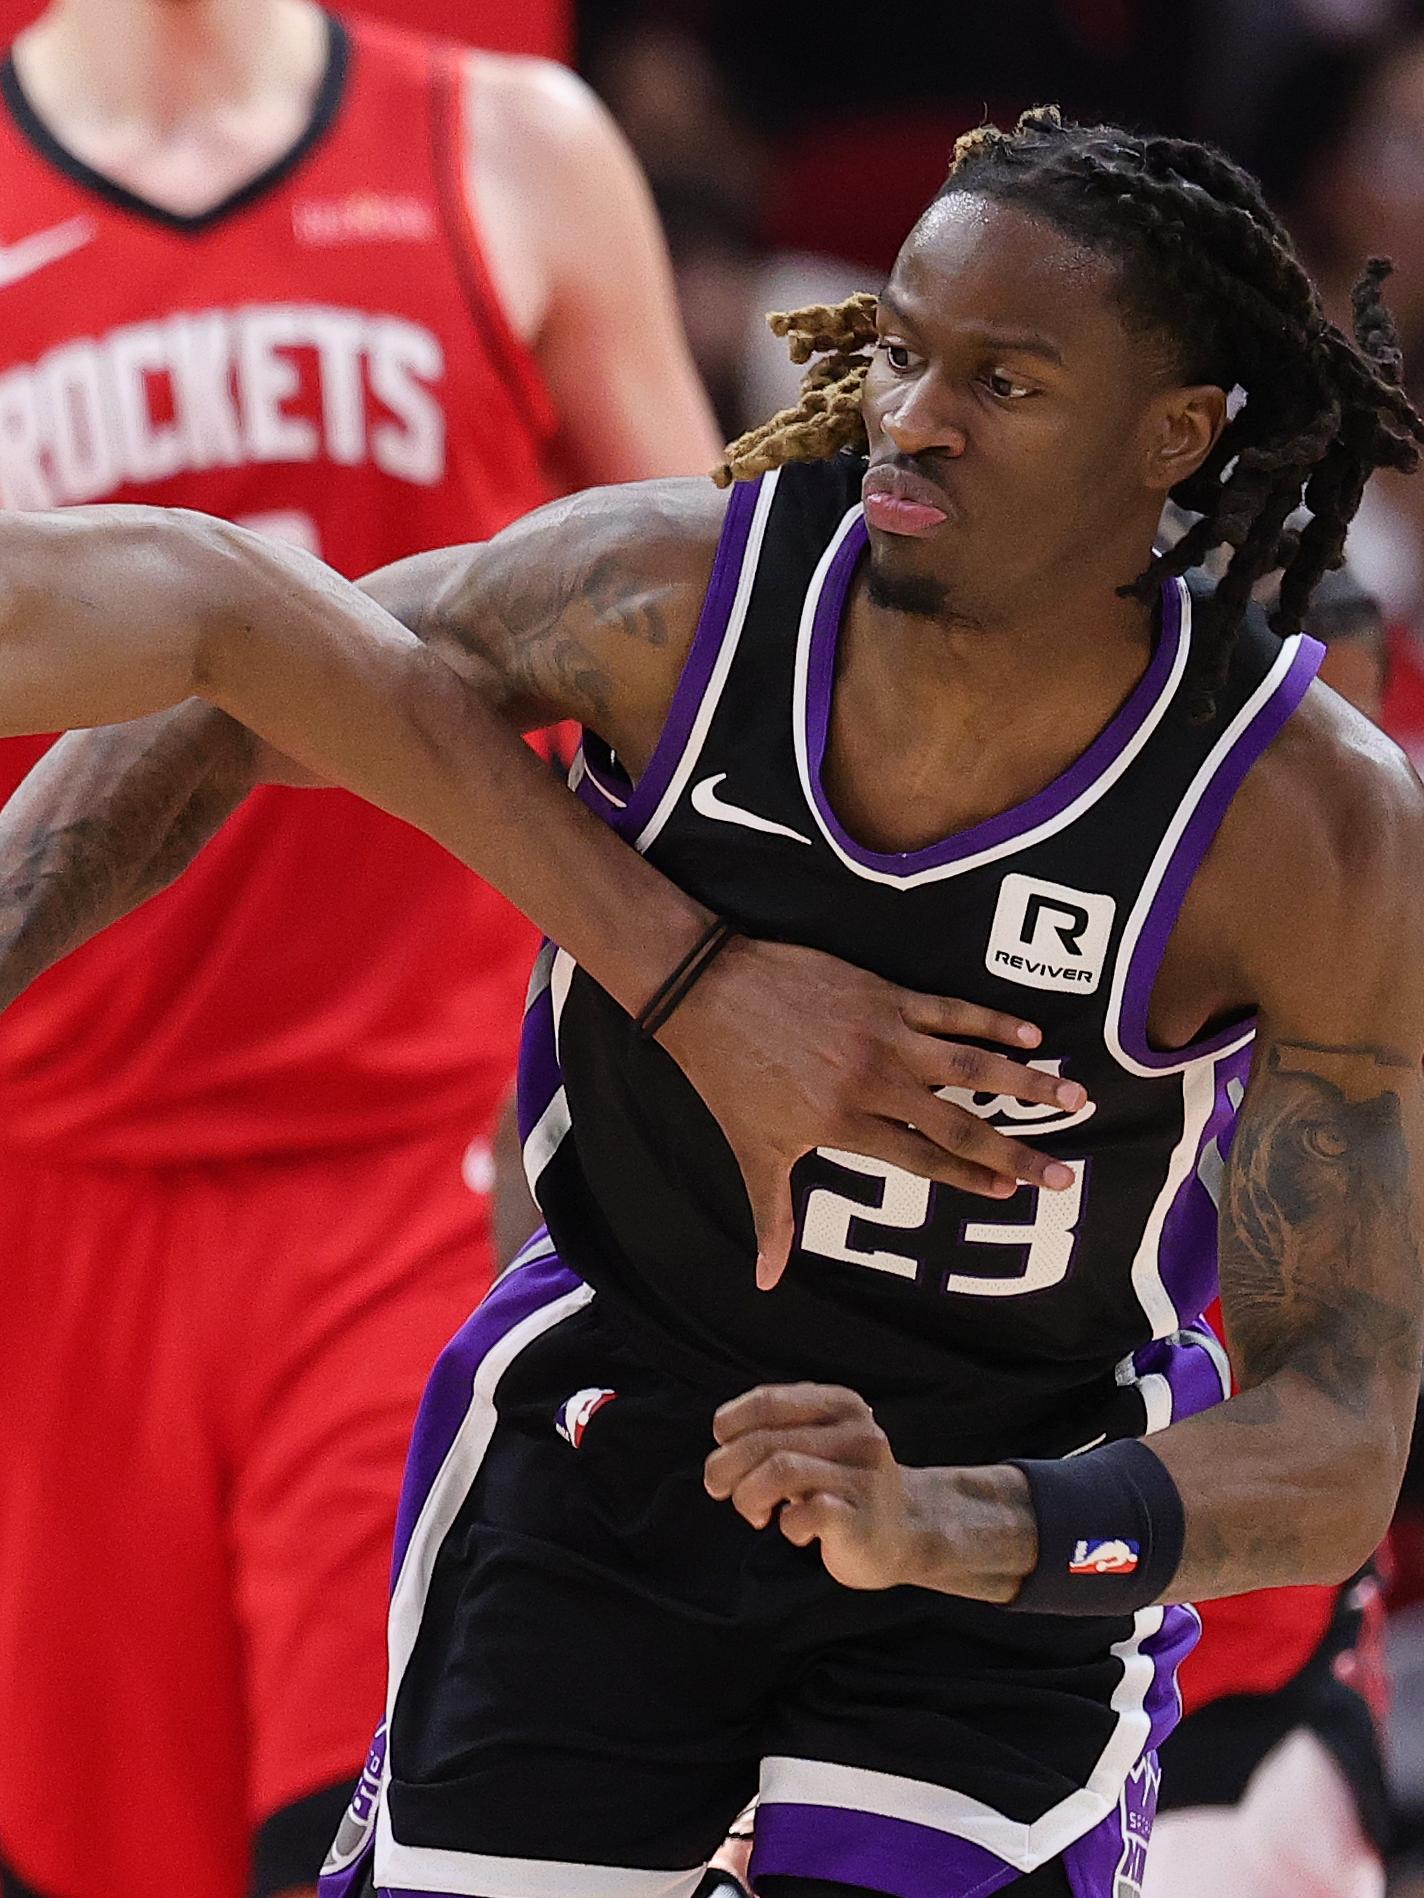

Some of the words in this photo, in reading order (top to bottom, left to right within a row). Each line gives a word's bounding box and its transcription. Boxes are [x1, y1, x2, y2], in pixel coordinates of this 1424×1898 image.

[1019, 893, 1089, 956] R
[994, 950, 1093, 983] REVIVER
[800, 1146, 1087, 1298] 23
